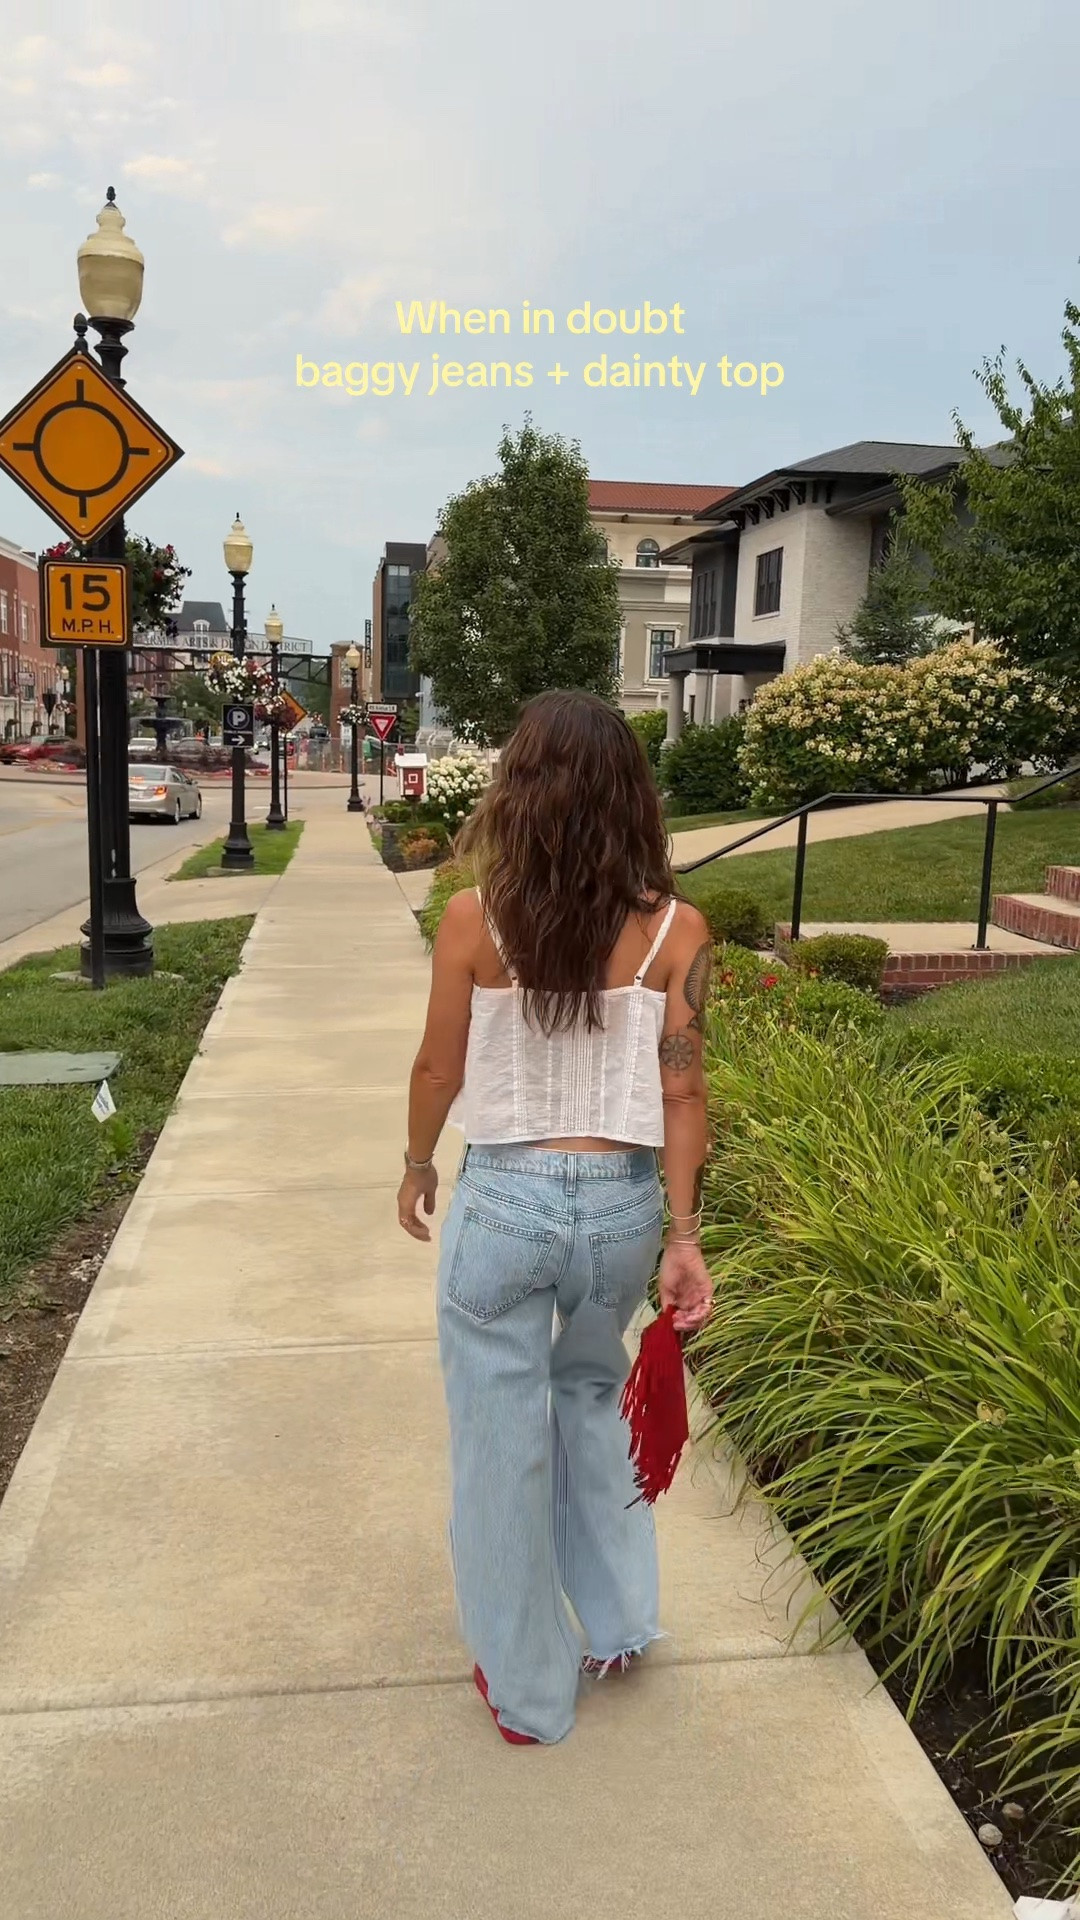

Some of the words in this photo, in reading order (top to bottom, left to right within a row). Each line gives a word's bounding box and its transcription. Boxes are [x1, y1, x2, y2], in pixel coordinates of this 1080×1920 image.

[59, 572, 111, 613] 15
[62, 617, 115, 635] M.P.H.
[183, 636, 208, 648] ARTS
[263, 640, 308, 653] DTRICT
[232, 710, 247, 726] P
